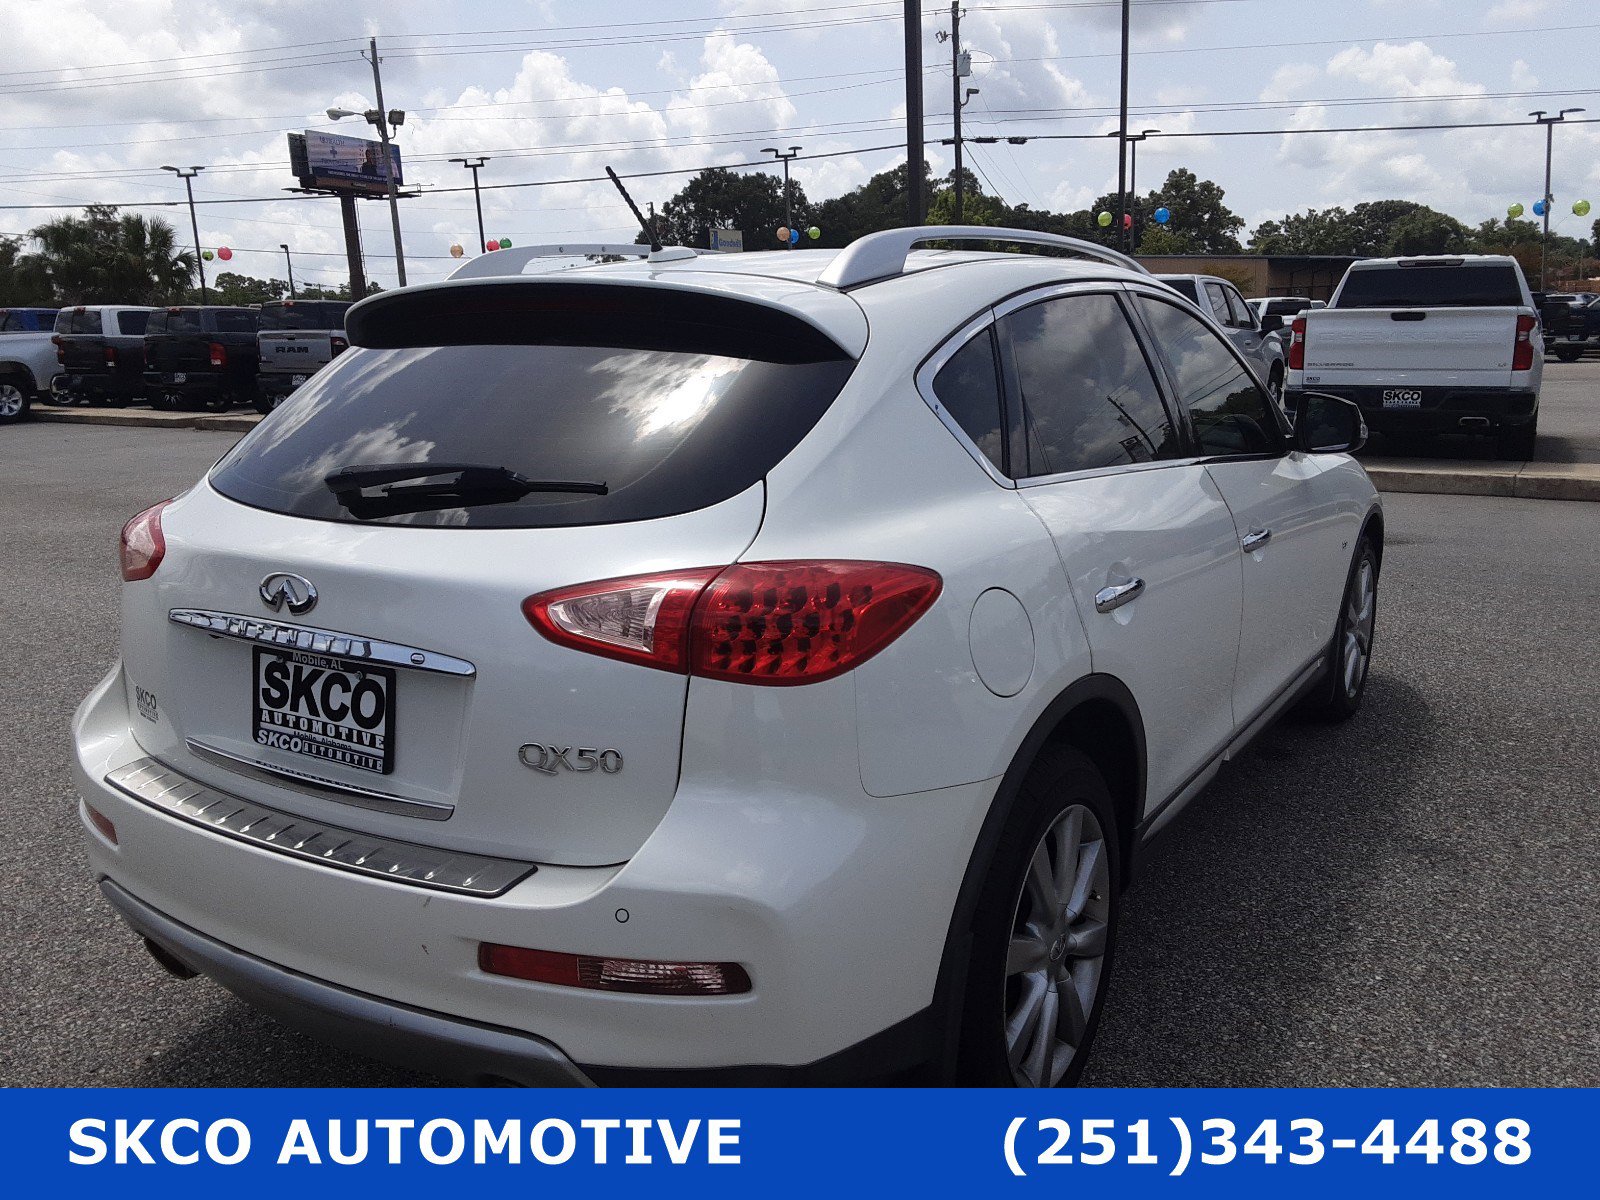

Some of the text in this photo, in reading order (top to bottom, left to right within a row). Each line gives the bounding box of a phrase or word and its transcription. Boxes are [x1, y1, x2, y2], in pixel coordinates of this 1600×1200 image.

[275, 346, 309, 354] RAM
[1384, 391, 1421, 401] SKCO
[292, 651, 345, 671] Mobile, AL
[136, 685, 157, 710] SKCO
[261, 660, 386, 730] SKCO
[261, 709, 385, 750] AUTOMOTIVE
[256, 729, 384, 772] SKCO AUTOMOTIVE
[518, 742, 624, 776] QX50
